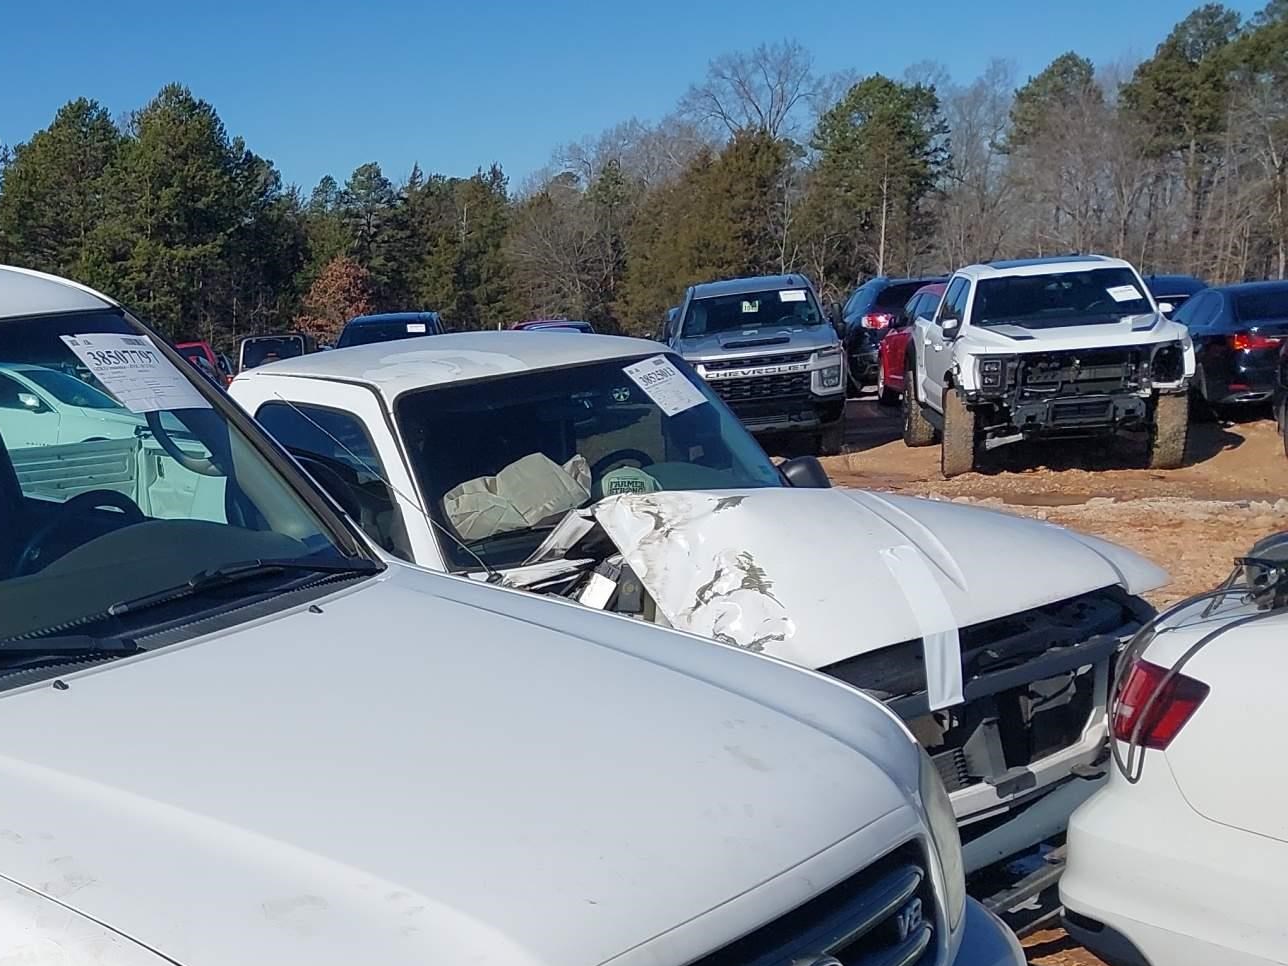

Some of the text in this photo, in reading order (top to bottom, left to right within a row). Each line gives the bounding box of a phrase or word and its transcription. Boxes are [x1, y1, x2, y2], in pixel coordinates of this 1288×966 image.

[86, 349, 160, 367] 38507797
[639, 366, 676, 387] 38525013
[704, 363, 811, 380] CHEVROLET
